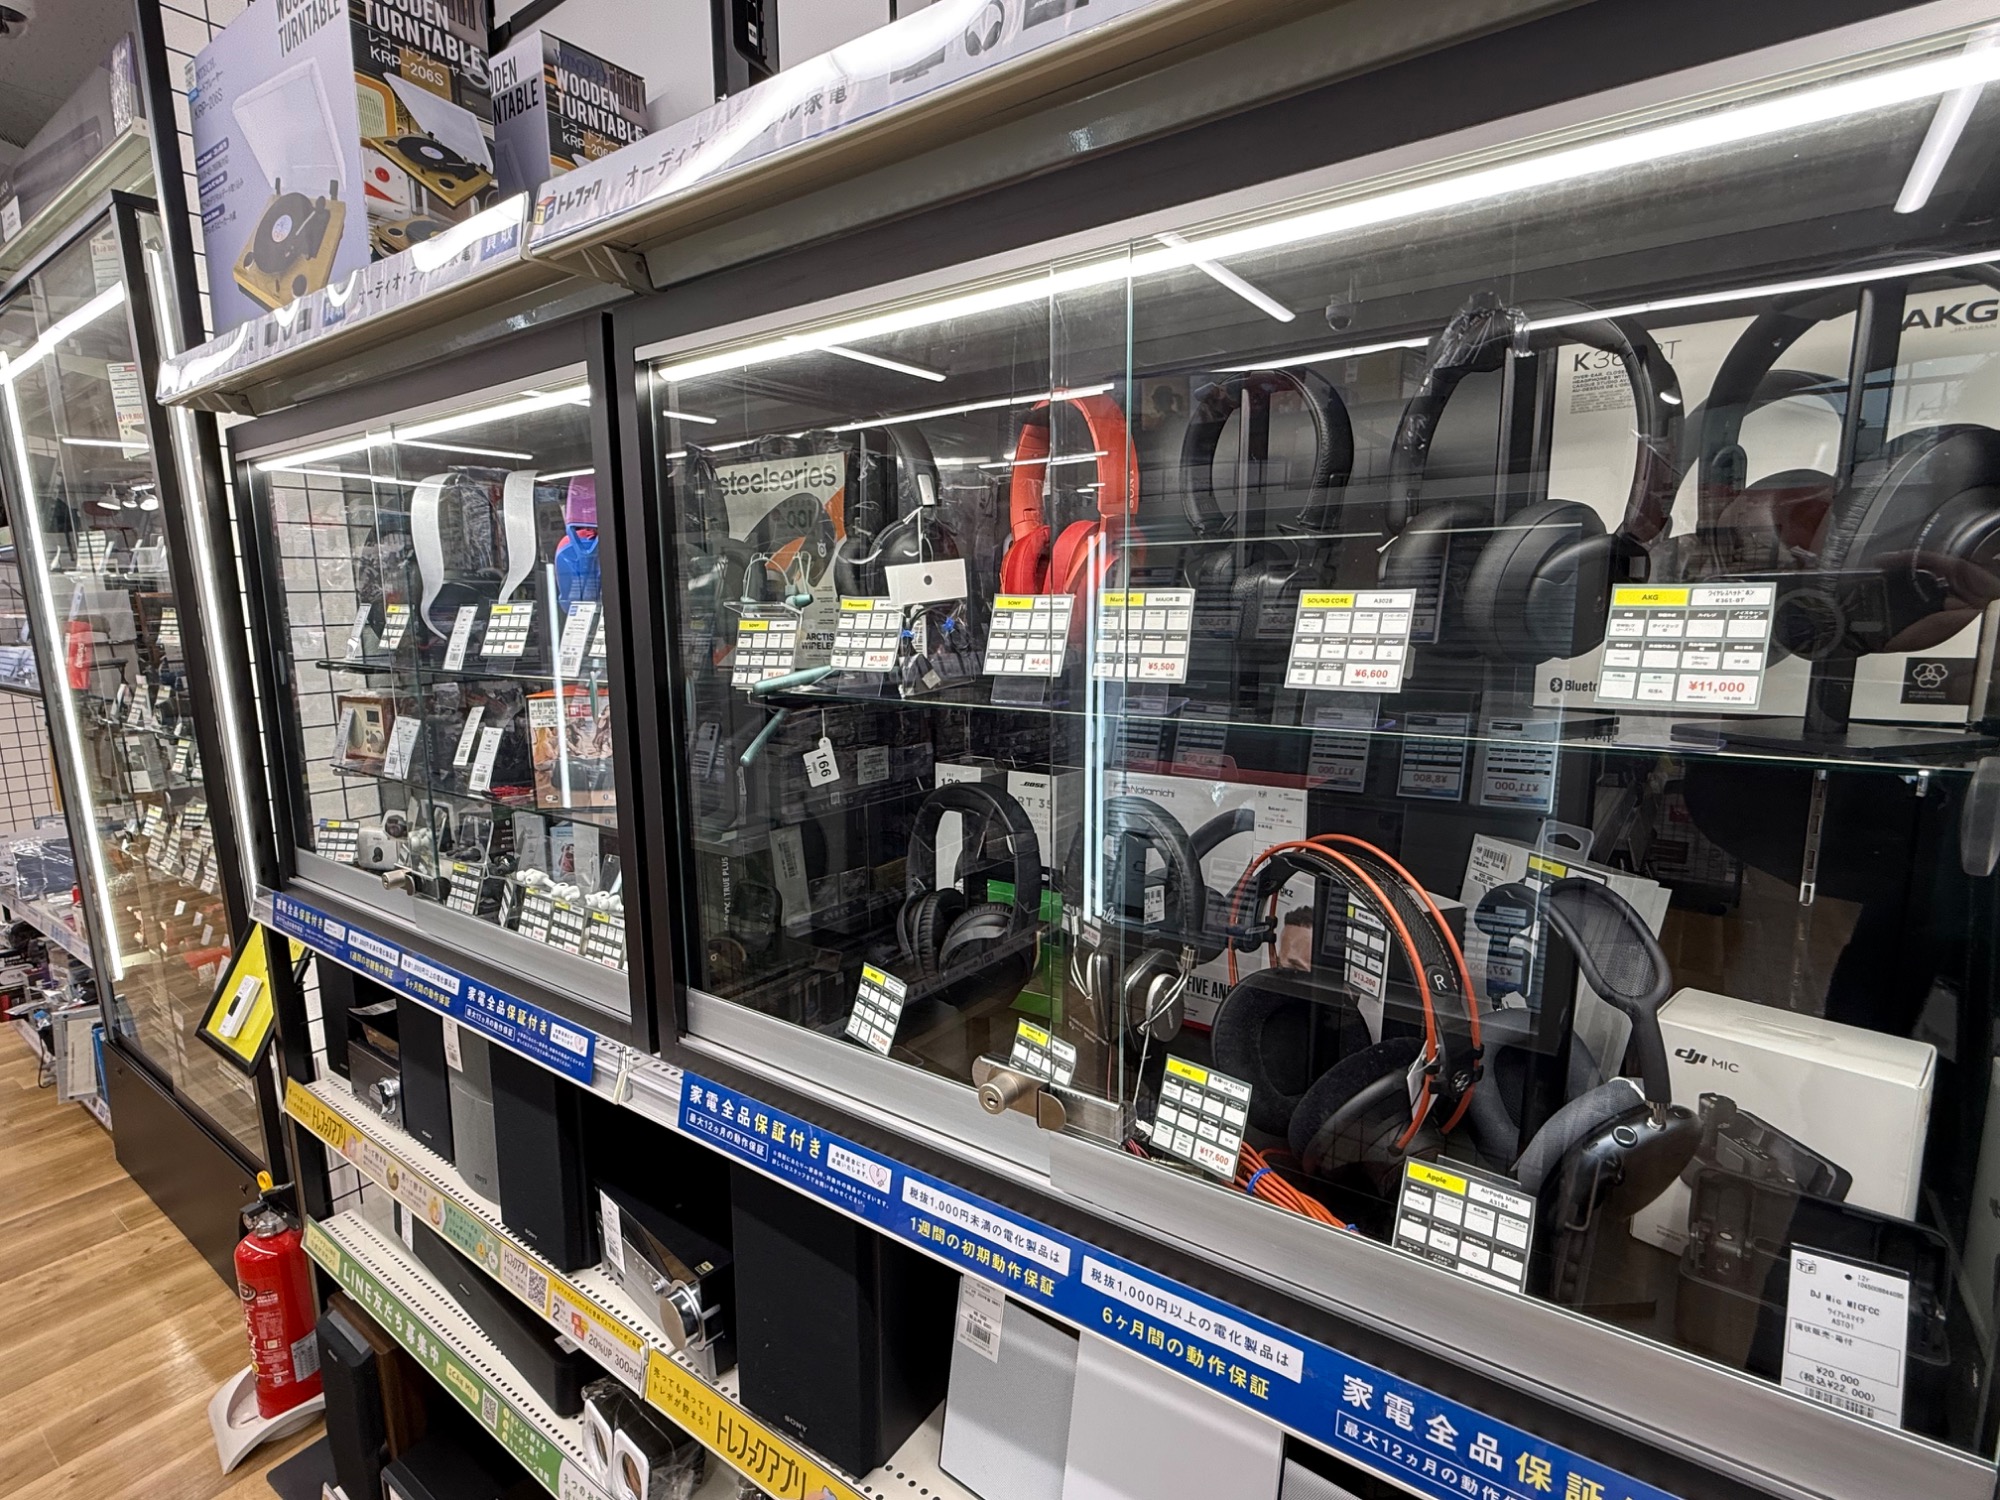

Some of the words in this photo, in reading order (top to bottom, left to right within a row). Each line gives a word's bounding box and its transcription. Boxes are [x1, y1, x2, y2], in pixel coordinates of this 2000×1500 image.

[364, 0, 481, 72] TURNTABLE
[370, 45, 444, 87] KRP-206S
[554, 65, 621, 115] WOODEN
[556, 92, 644, 144] TURNTABLE
[556, 179, 602, 215] トレファク
[1901, 299, 1999, 332] AKG
[717, 461, 837, 496] steelseries
[1031, 657, 1051, 665] ¥4,40
[1148, 662, 1175, 671] ¥5,500
[1355, 669, 1388, 679] ¥6,600
[1688, 680, 1745, 693] ¥11,000
[815, 752, 832, 778] 166
[1020, 781, 1048, 789] BOSE
[1129, 784, 1176, 798] Nakamichi
[721, 857, 729, 878] PLUS
[722, 878, 731, 896] TRUE
[1186, 975, 1209, 996] FIVE
[1433, 974, 1448, 991] R
[467, 985, 548, 1037] 家電全品保証付き
[1711, 1058, 1740, 1073] MIC
[689, 1084, 822, 1160] 家電全品保証付き
[1199, 1145, 1229, 1166] ¥17,600
[1426, 1172, 1447, 1184] Apple
[1480, 1187, 1505, 1201] AirPods
[909, 1186, 1060, 1264] 税抜1,000円未満の電化製品は
[909, 1216, 1055, 1297] 1週間の初期動作保証
[342, 1261, 440, 1367] LINE友だち募集中
[1090, 1267, 1289, 1367] 税抜1,000円以上の電化製品は
[653, 1366, 713, 1417] 売っても買っても
[784, 1414, 808, 1433] SONY
[1342, 1374, 1634, 1500] 家電全品保証
[716, 1409, 807, 1500] トレファクアプリ
[1343, 1420, 1516, 1500] 最大12ヵ月の動作
